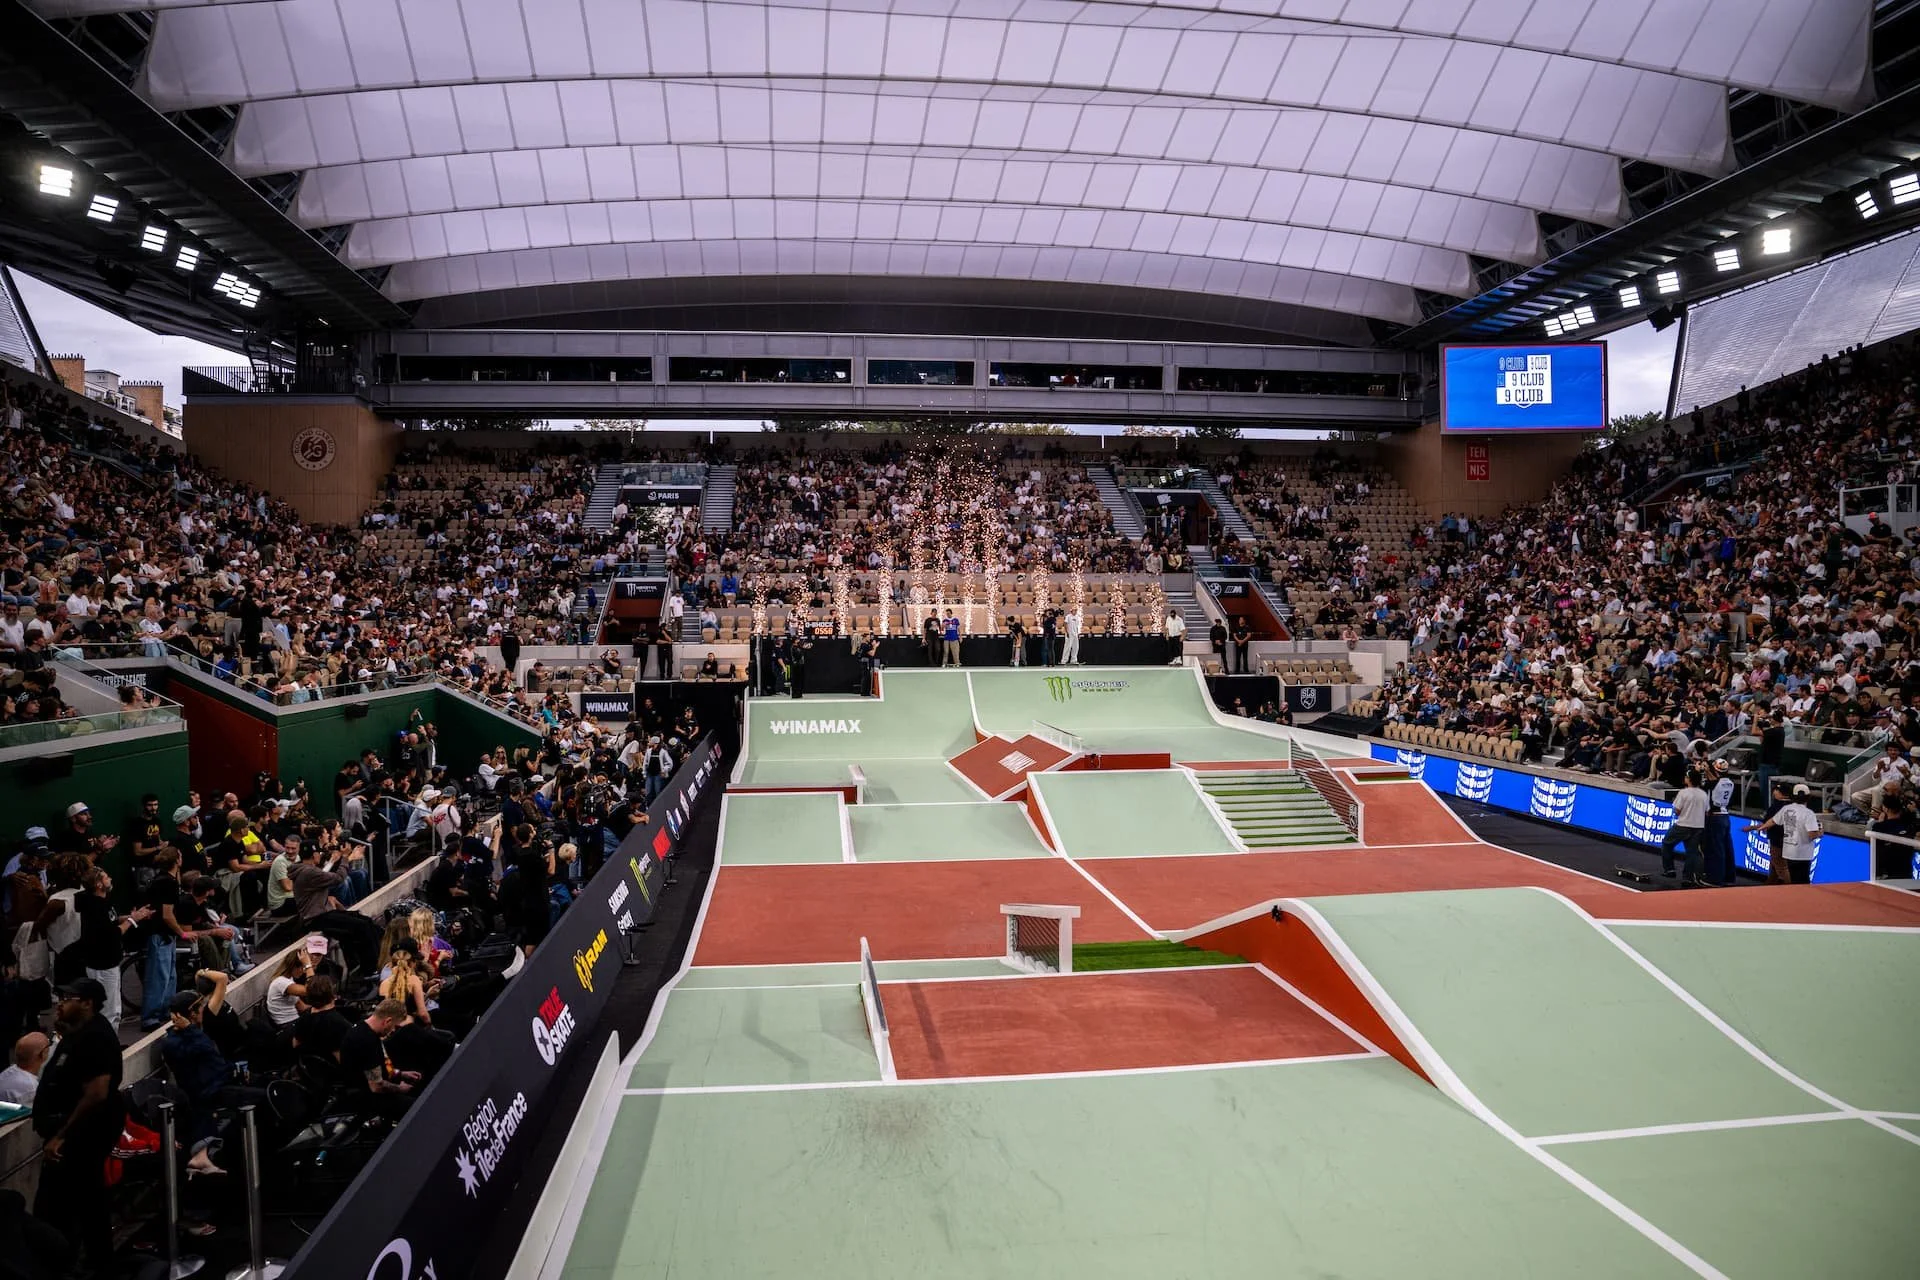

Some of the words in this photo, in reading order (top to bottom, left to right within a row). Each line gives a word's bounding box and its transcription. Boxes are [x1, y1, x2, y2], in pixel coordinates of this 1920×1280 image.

[1512, 373, 1517, 386] 9
[1520, 373, 1544, 386] CLUB
[1505, 389, 1510, 402] 9
[1515, 389, 1543, 402] CLUB
[1469, 446, 1486, 458] TEN
[1470, 464, 1486, 476] NIS
[657, 492, 680, 500] PARIS
[1302, 688, 1315, 697] SLS
[585, 701, 629, 713] WINAMAX
[769, 719, 862, 735] WINAMAX
[1723, 790, 1730, 800] 2
[585, 928, 608, 969] RAM
[538, 985, 564, 1030] TRUE
[550, 1003, 576, 1053] SKATE
[463, 1097, 498, 1152] Région
